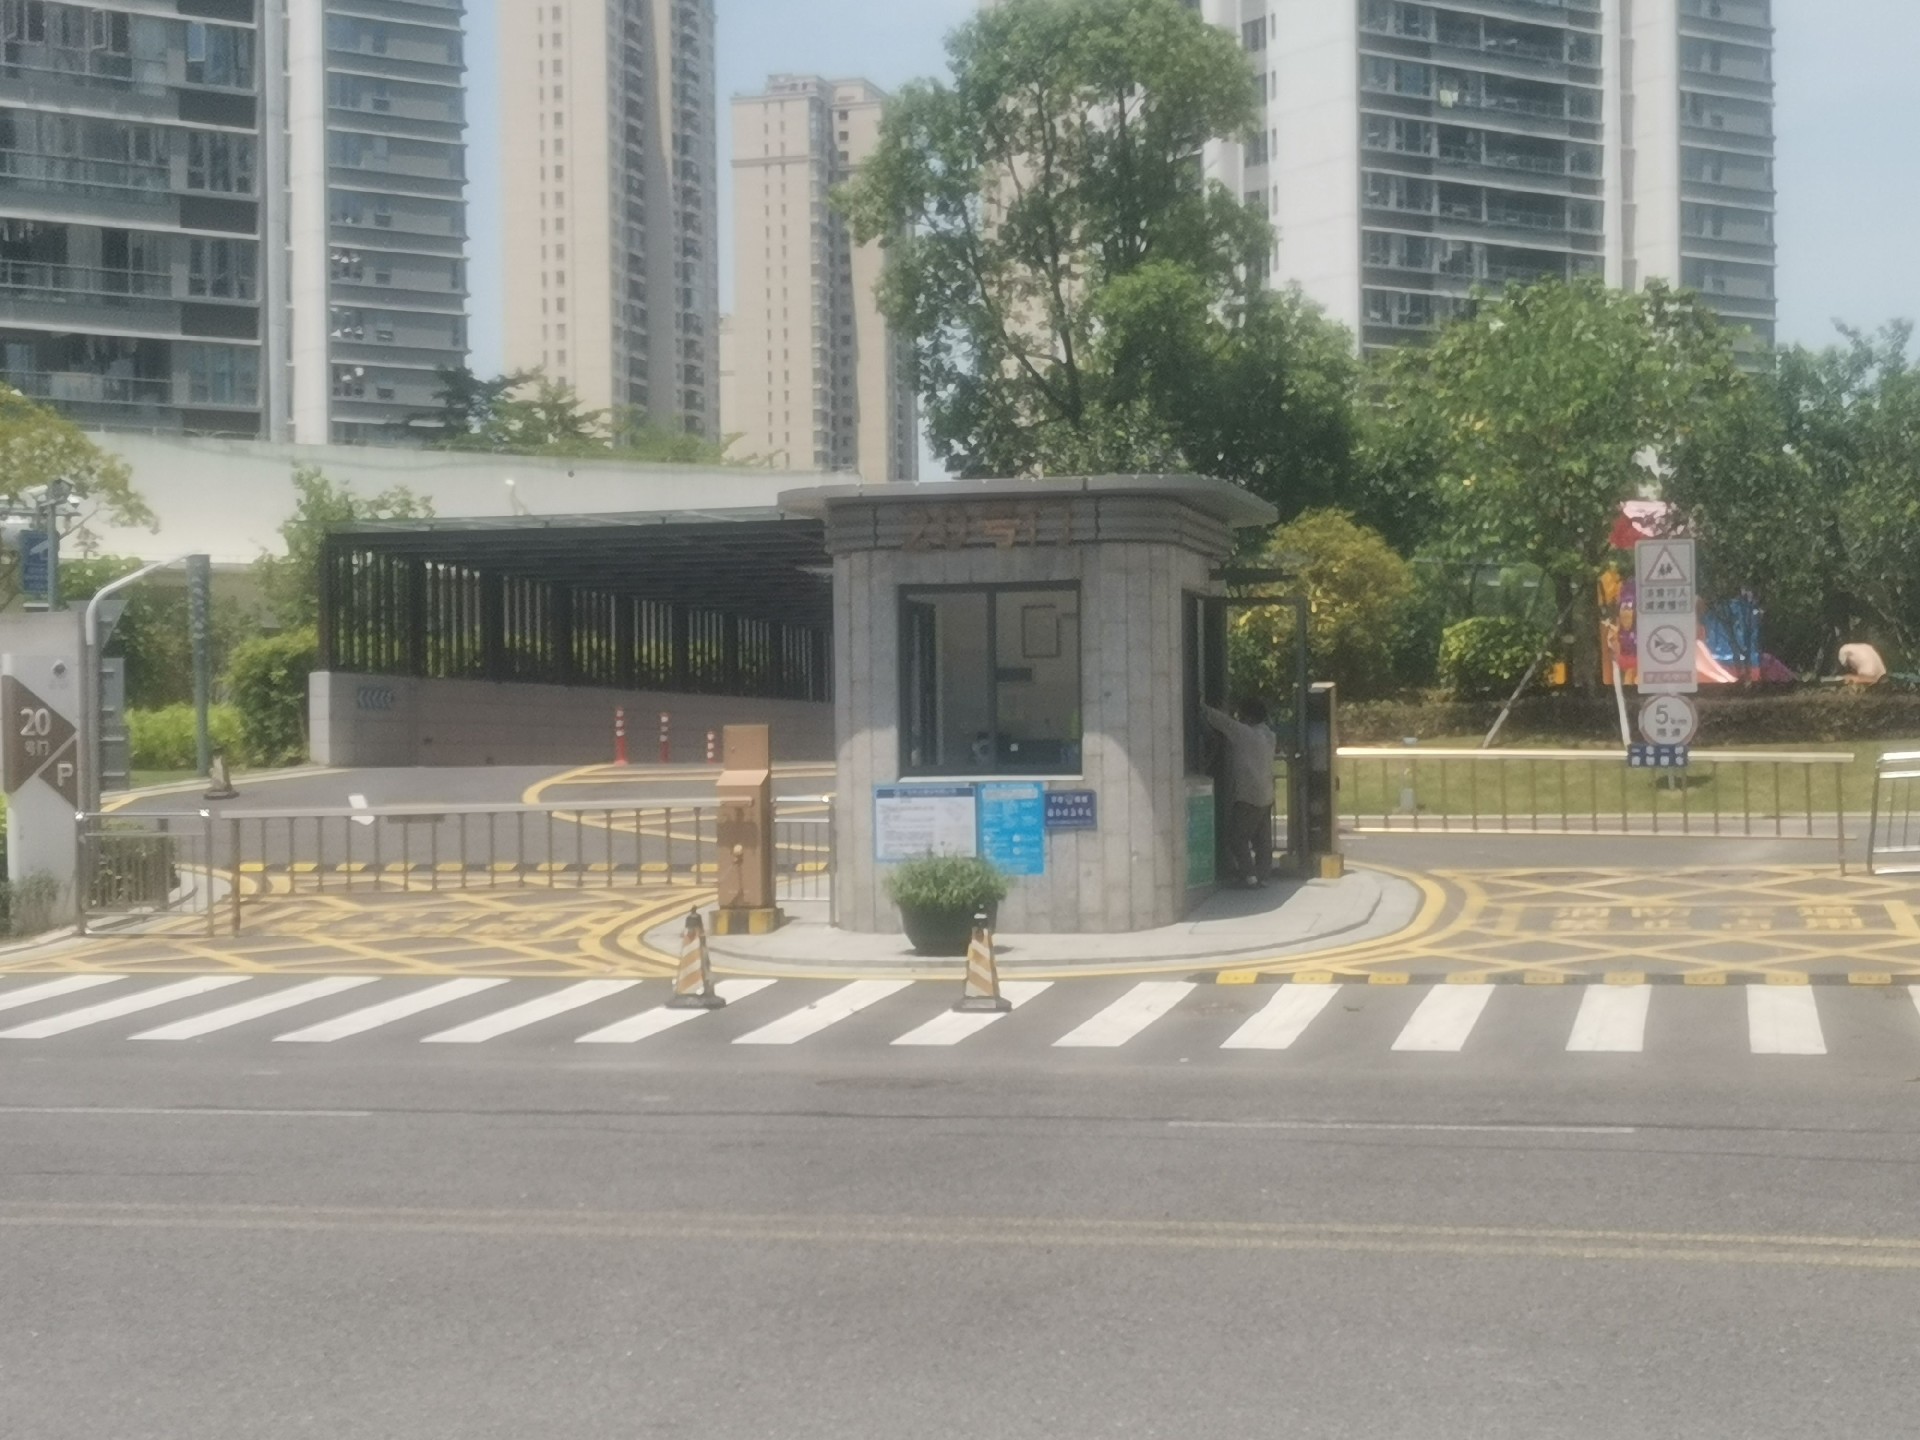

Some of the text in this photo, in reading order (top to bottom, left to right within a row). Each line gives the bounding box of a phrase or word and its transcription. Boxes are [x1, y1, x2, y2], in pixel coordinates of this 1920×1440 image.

[20, 708, 50, 736] 20
[25, 740, 49, 756] 号门
[57, 763, 73, 787] P
